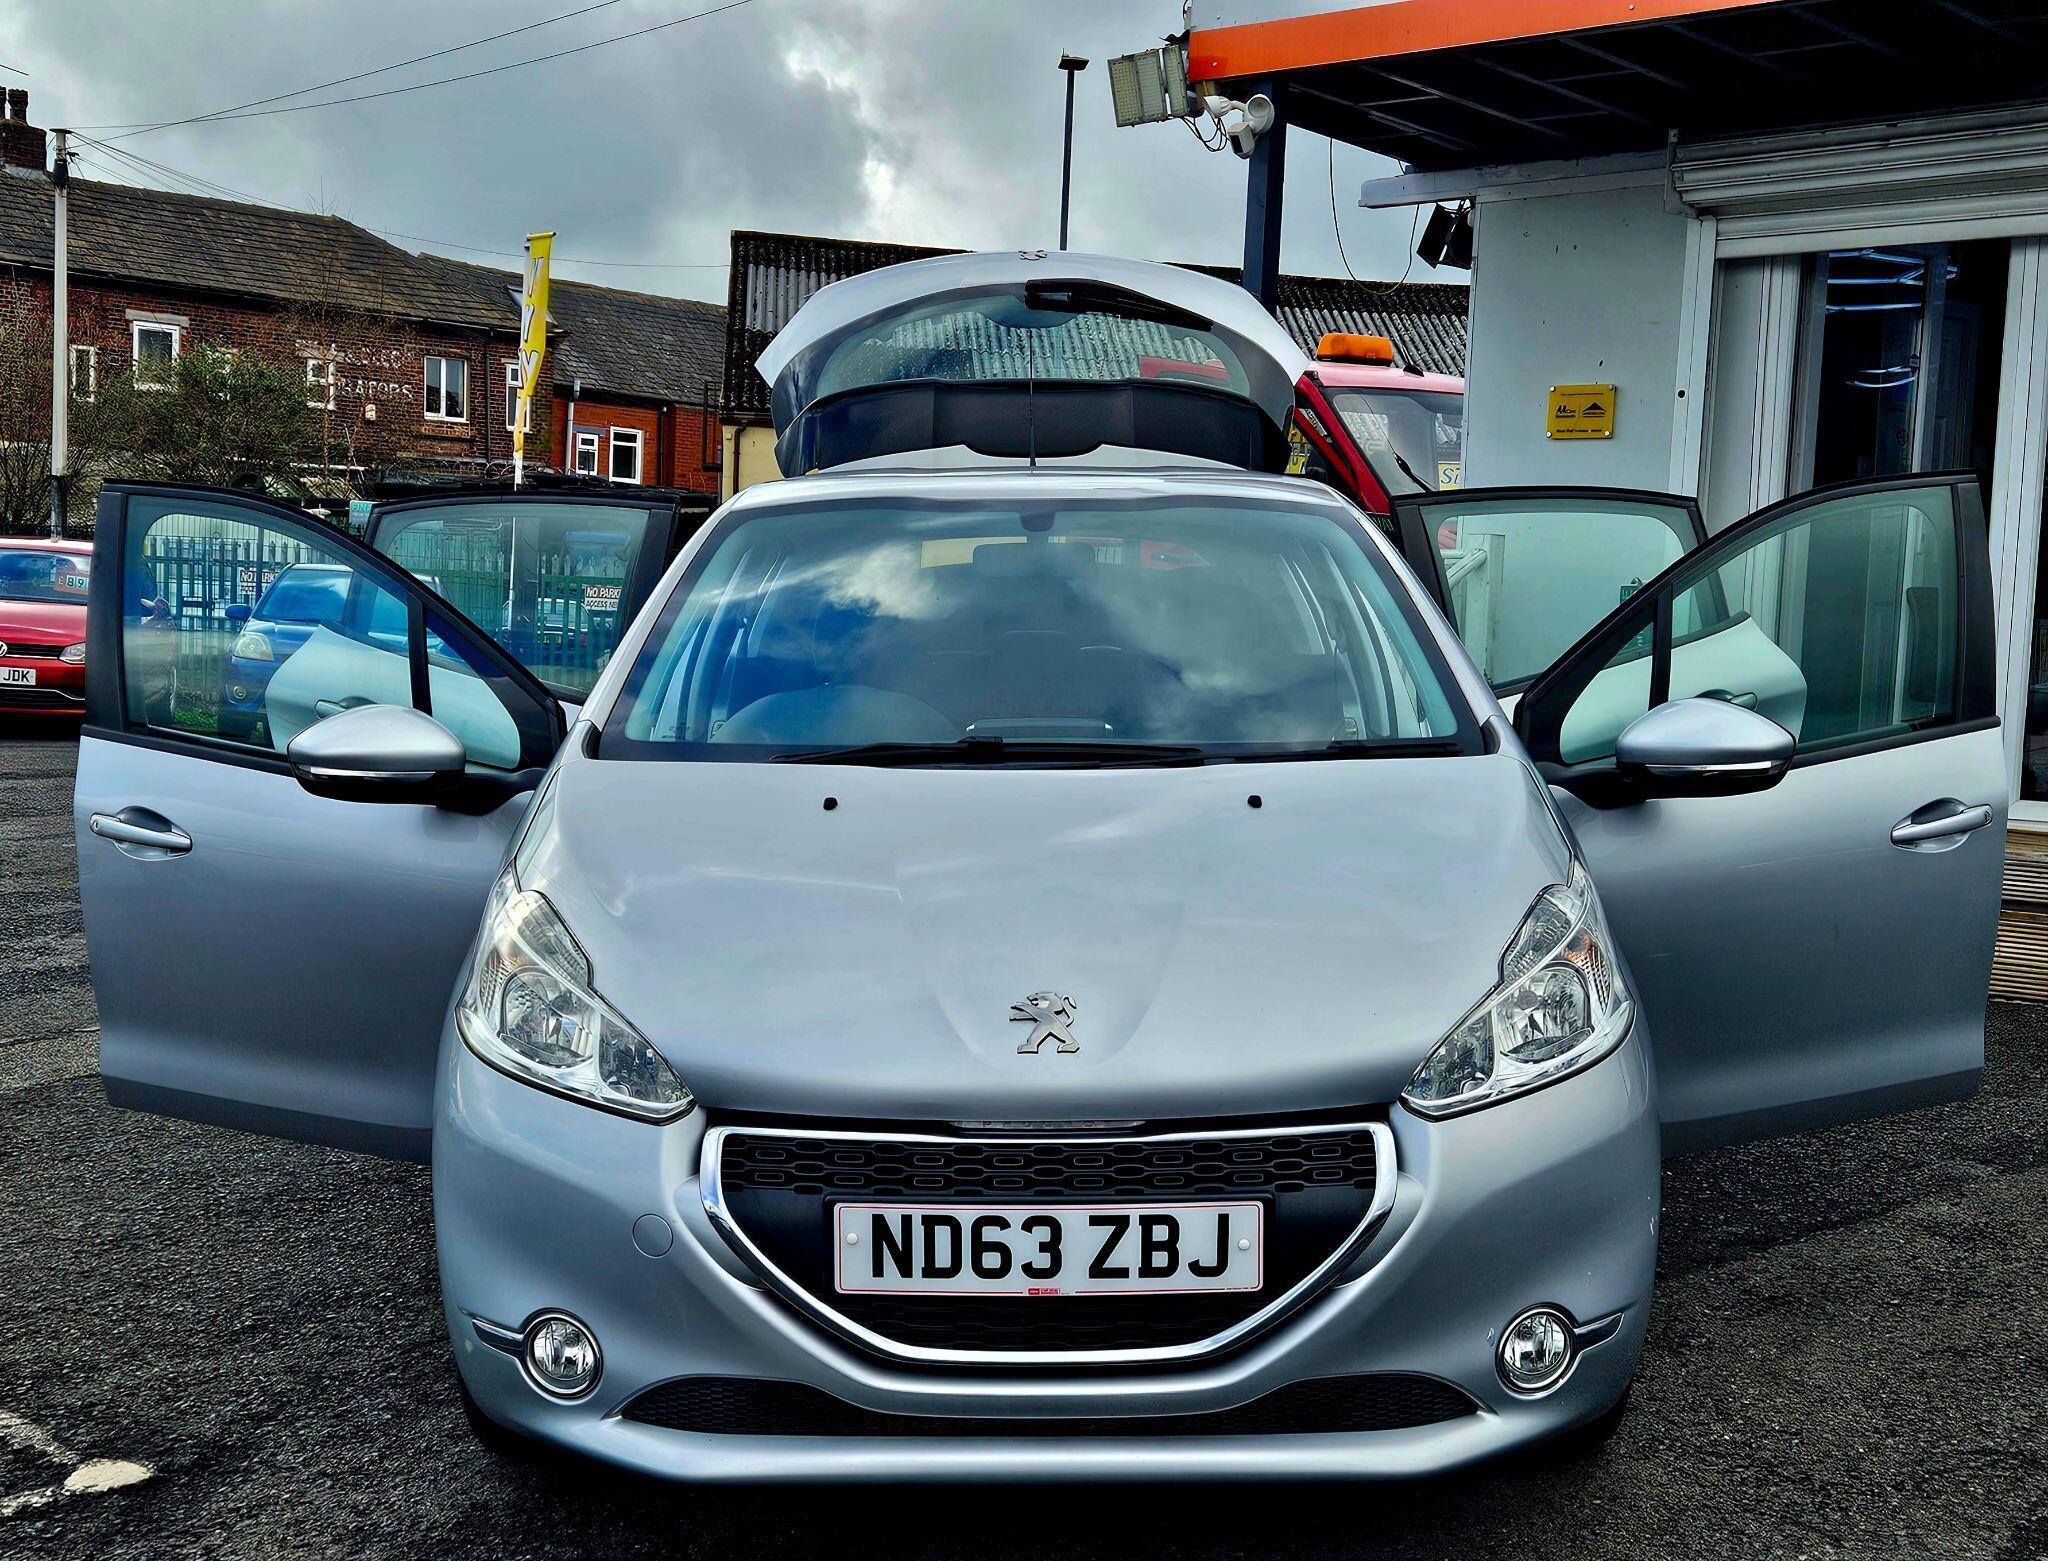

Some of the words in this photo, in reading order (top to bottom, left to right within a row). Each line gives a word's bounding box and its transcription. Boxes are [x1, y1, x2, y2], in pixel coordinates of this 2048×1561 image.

[586, 587, 599, 597] NO
[3, 669, 30, 683] JDK
[871, 1212, 1063, 1280] ND63
[1088, 1212, 1230, 1280] ZBJ
